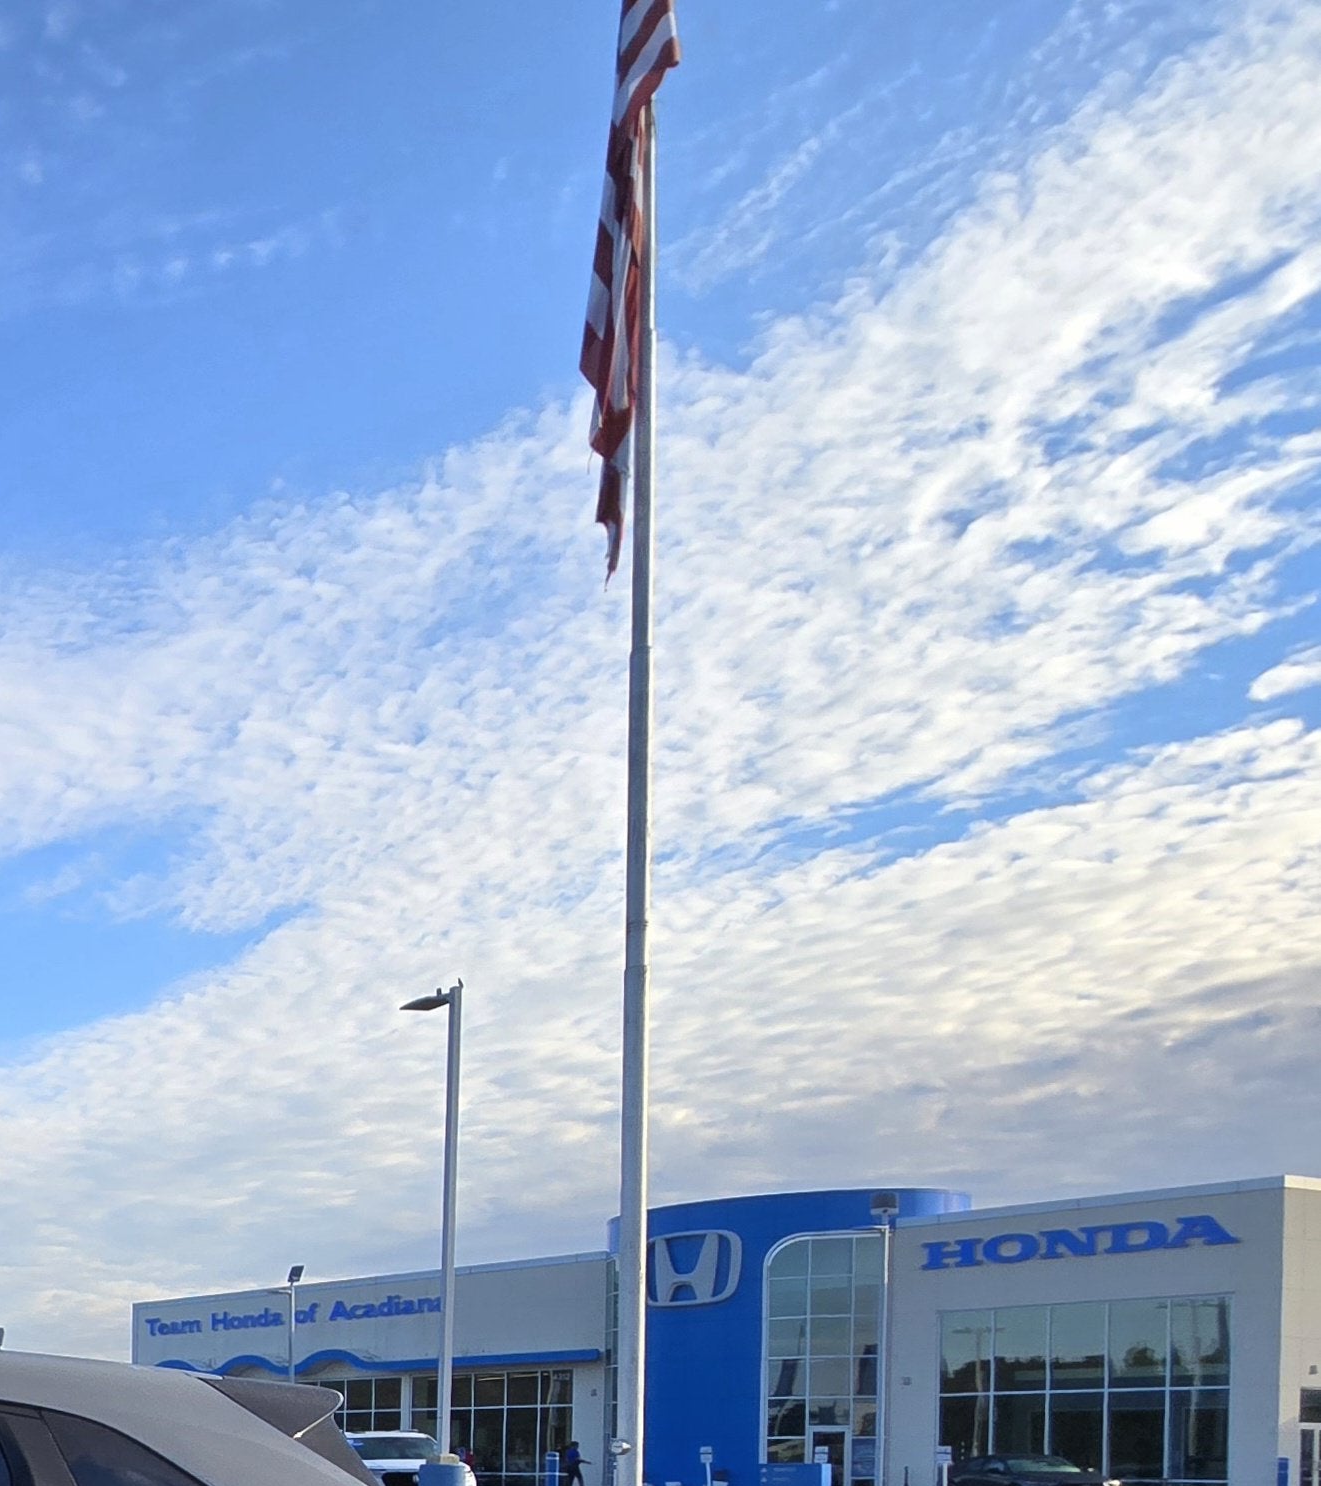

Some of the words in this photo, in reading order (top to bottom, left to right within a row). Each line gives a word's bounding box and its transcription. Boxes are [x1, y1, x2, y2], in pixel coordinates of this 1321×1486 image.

[921, 1214, 1242, 1271] HONDA
[145, 1317, 202, 1336] Team
[210, 1307, 285, 1332] Honda
[294, 1302, 319, 1324] of
